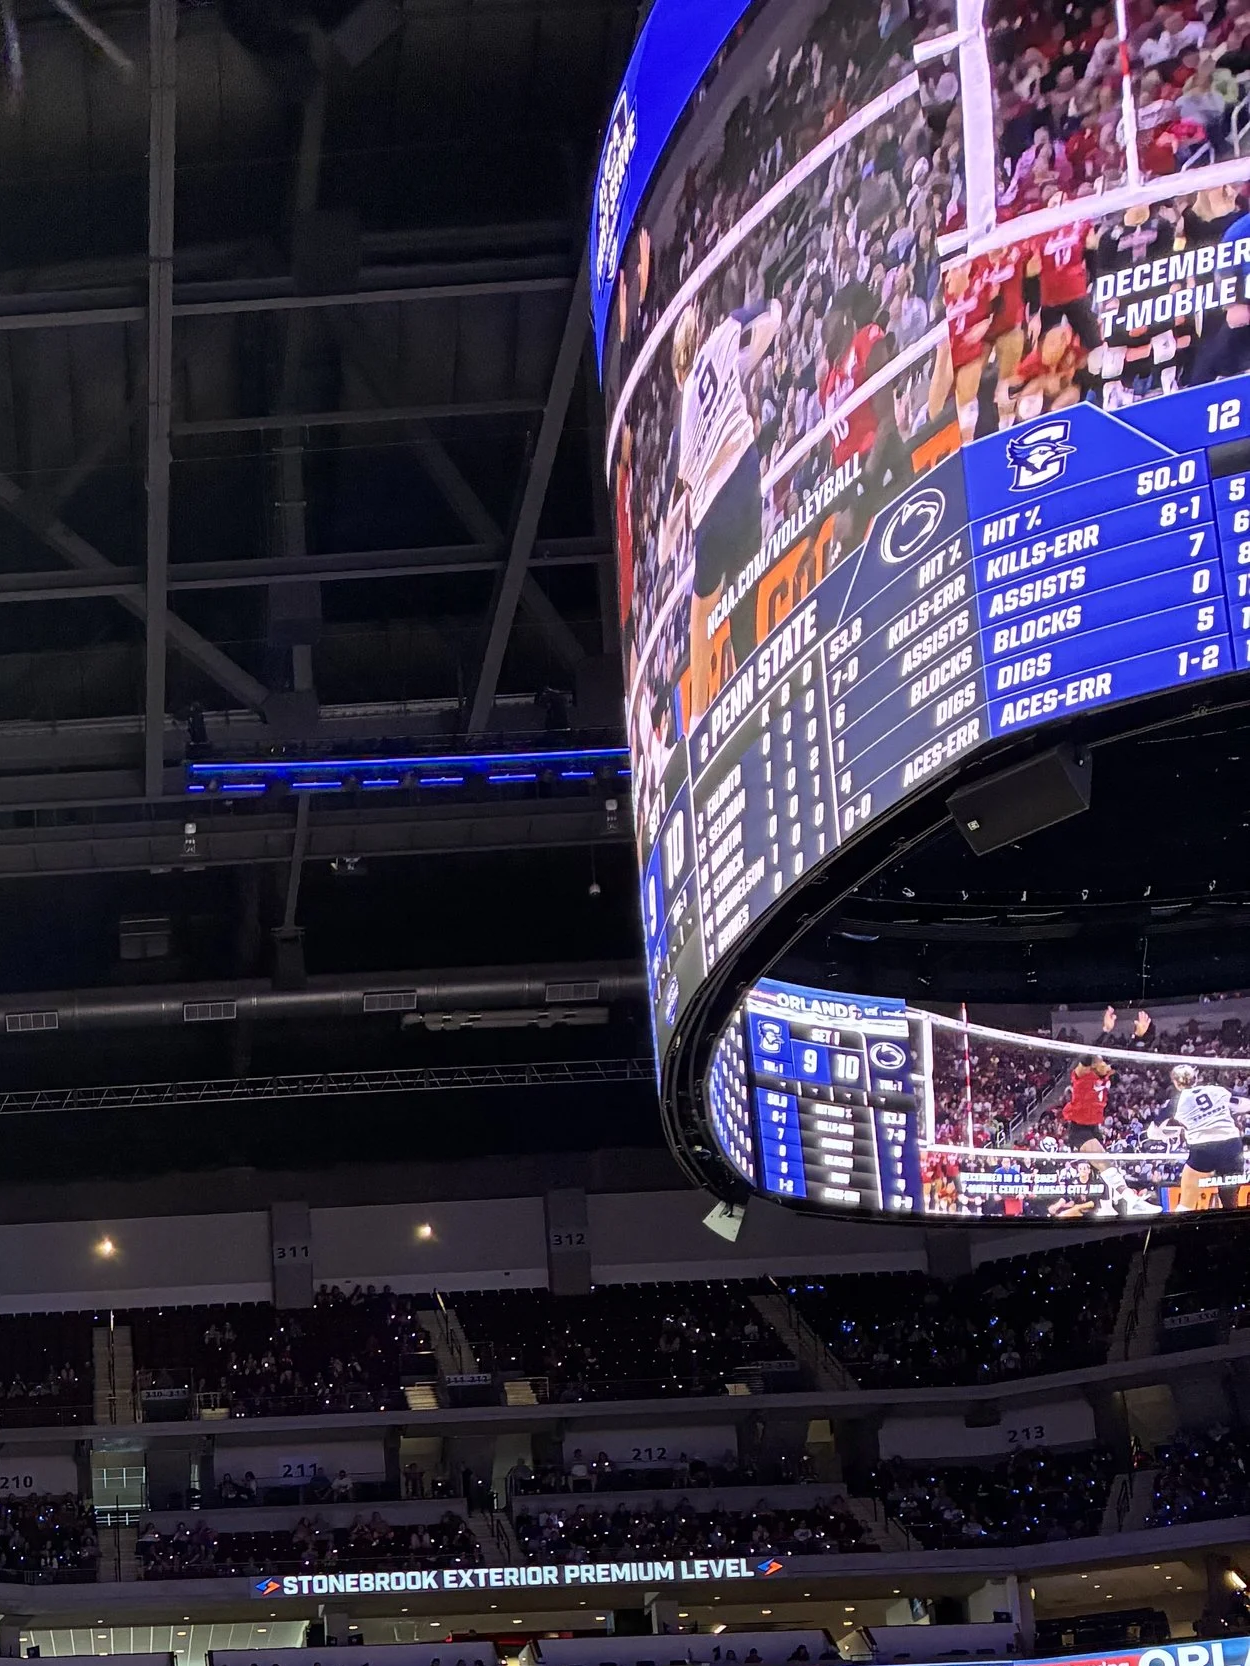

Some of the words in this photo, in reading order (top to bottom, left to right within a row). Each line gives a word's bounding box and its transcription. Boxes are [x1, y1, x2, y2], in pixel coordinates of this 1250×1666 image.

[1100, 277, 1236, 338] T-MOBILE
[1207, 399, 1241, 433] 12
[982, 512, 1020, 546] HIT
[1025, 505, 1042, 530] %
[1137, 460, 1196, 496] 50.0
[1229, 477, 1246, 501] 5
[707, 452, 862, 639] NCAA.COM/VOLLEYBALL
[986, 524, 1099, 581] KILLS-ERR
[1160, 496, 1200, 527] 8-1
[1234, 509, 1250, 533] 6
[829, 618, 862, 662] 53.8
[919, 556, 944, 589] HIT
[949, 539, 962, 566] %
[989, 566, 1086, 618] ASSISTS
[1189, 532, 1205, 556] 7
[832, 658, 859, 696] 7-0
[888, 574, 966, 650] KILLS-ERR
[993, 605, 1082, 653] BLOCKS
[1192, 569, 1210, 594] 0
[711, 665, 755, 747] PENN
[758, 600, 817, 690] STATE
[834, 704, 846, 729] 6
[901, 610, 969, 676] ASSISTS
[997, 653, 1052, 690] DIGS
[1196, 606, 1214, 632] 5
[837, 739, 846, 763] 1
[910, 646, 973, 707] BLOCKS
[1000, 673, 1112, 727] ACES-ERR
[1178, 645, 1219, 676] 1-2
[810, 746, 819, 770] 2
[841, 771, 852, 794] 4
[936, 682, 976, 726] DIGS
[845, 801, 871, 831] 0-0
[903, 718, 980, 788] ACES-ERR
[666, 810, 684, 889] 10
[803, 1049, 817, 1073] 9
[837, 1054, 859, 1080] 10
[1195, 1093, 1213, 1112] 9
[777, 1128, 784, 1140] 7
[277, 1246, 309, 1258] 311
[553, 1233, 585, 1245] 312
[632, 1447, 666, 1461] 212
[1008, 1425, 1045, 1443] 213
[0, 1476, 33, 1490] 210
[283, 1463, 317, 1478] 211
[283, 1572, 439, 1595] STONEBROOK
[444, 1566, 559, 1590] EXTERIOR
[564, 1562, 674, 1585] PREMIUM
[680, 1558, 754, 1579] LEVEL
